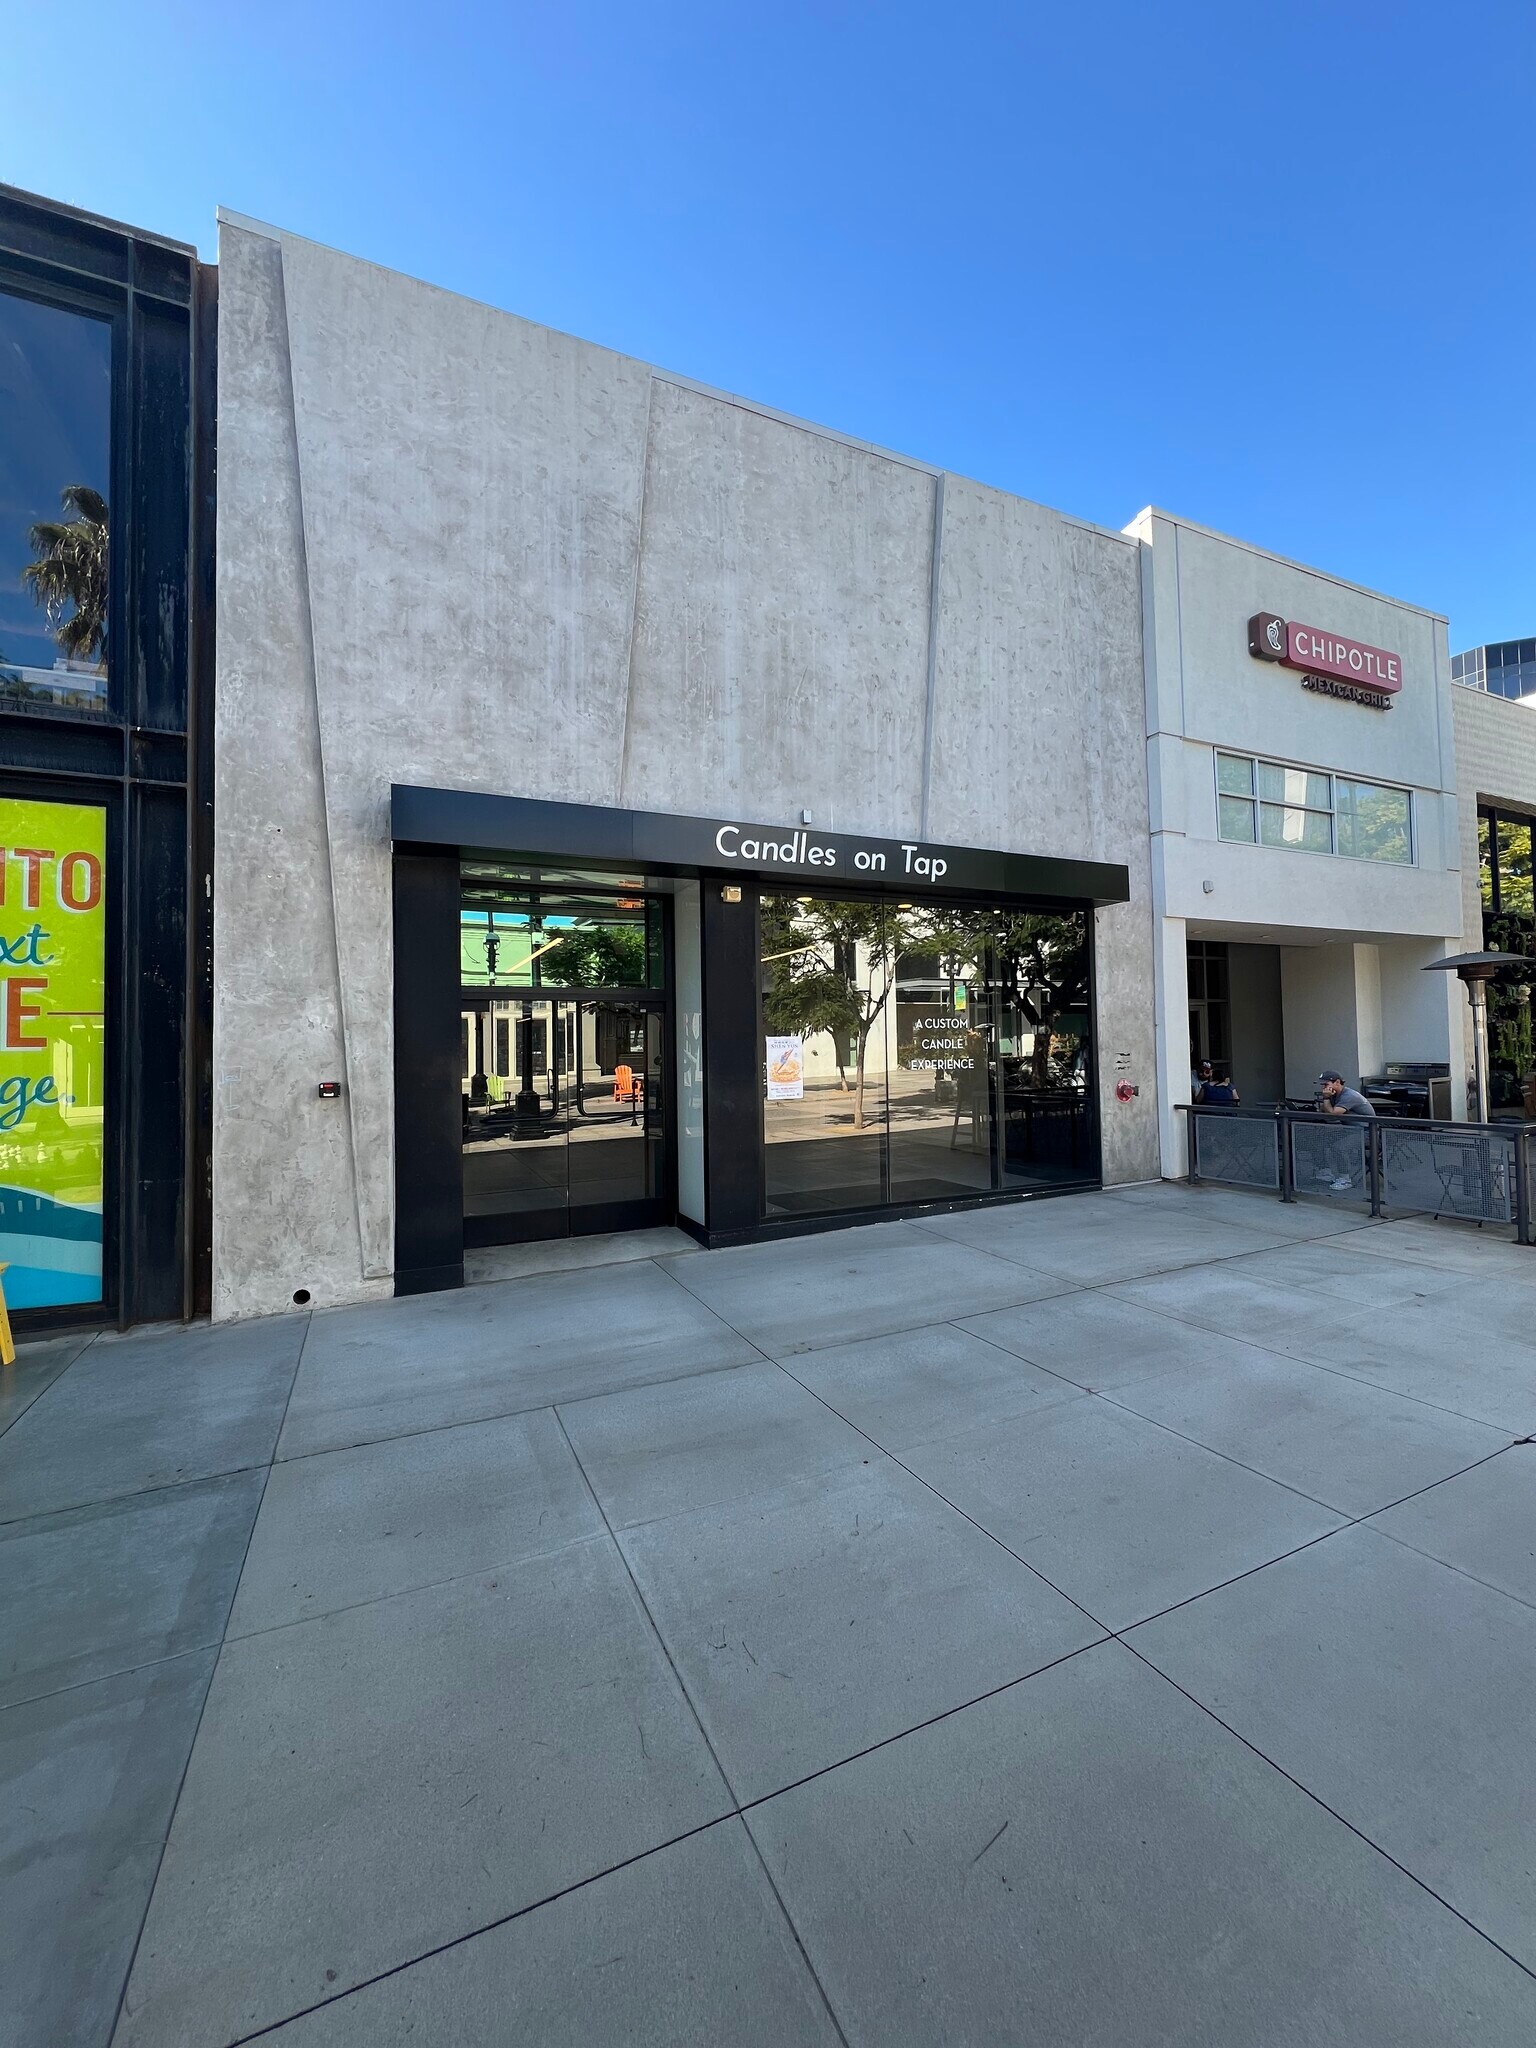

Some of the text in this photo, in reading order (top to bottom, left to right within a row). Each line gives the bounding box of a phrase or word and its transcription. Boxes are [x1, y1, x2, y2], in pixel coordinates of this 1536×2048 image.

[1295, 631, 1398, 682] CHIPOTLE
[1308, 674, 1360, 700] MEXICAN
[715, 825, 948, 882] Candles on Tap
[915, 1018, 968, 1029] A CUSTOM
[921, 1038, 964, 1050] CANDLE
[911, 1059, 975, 1070] EXPERIENCE
